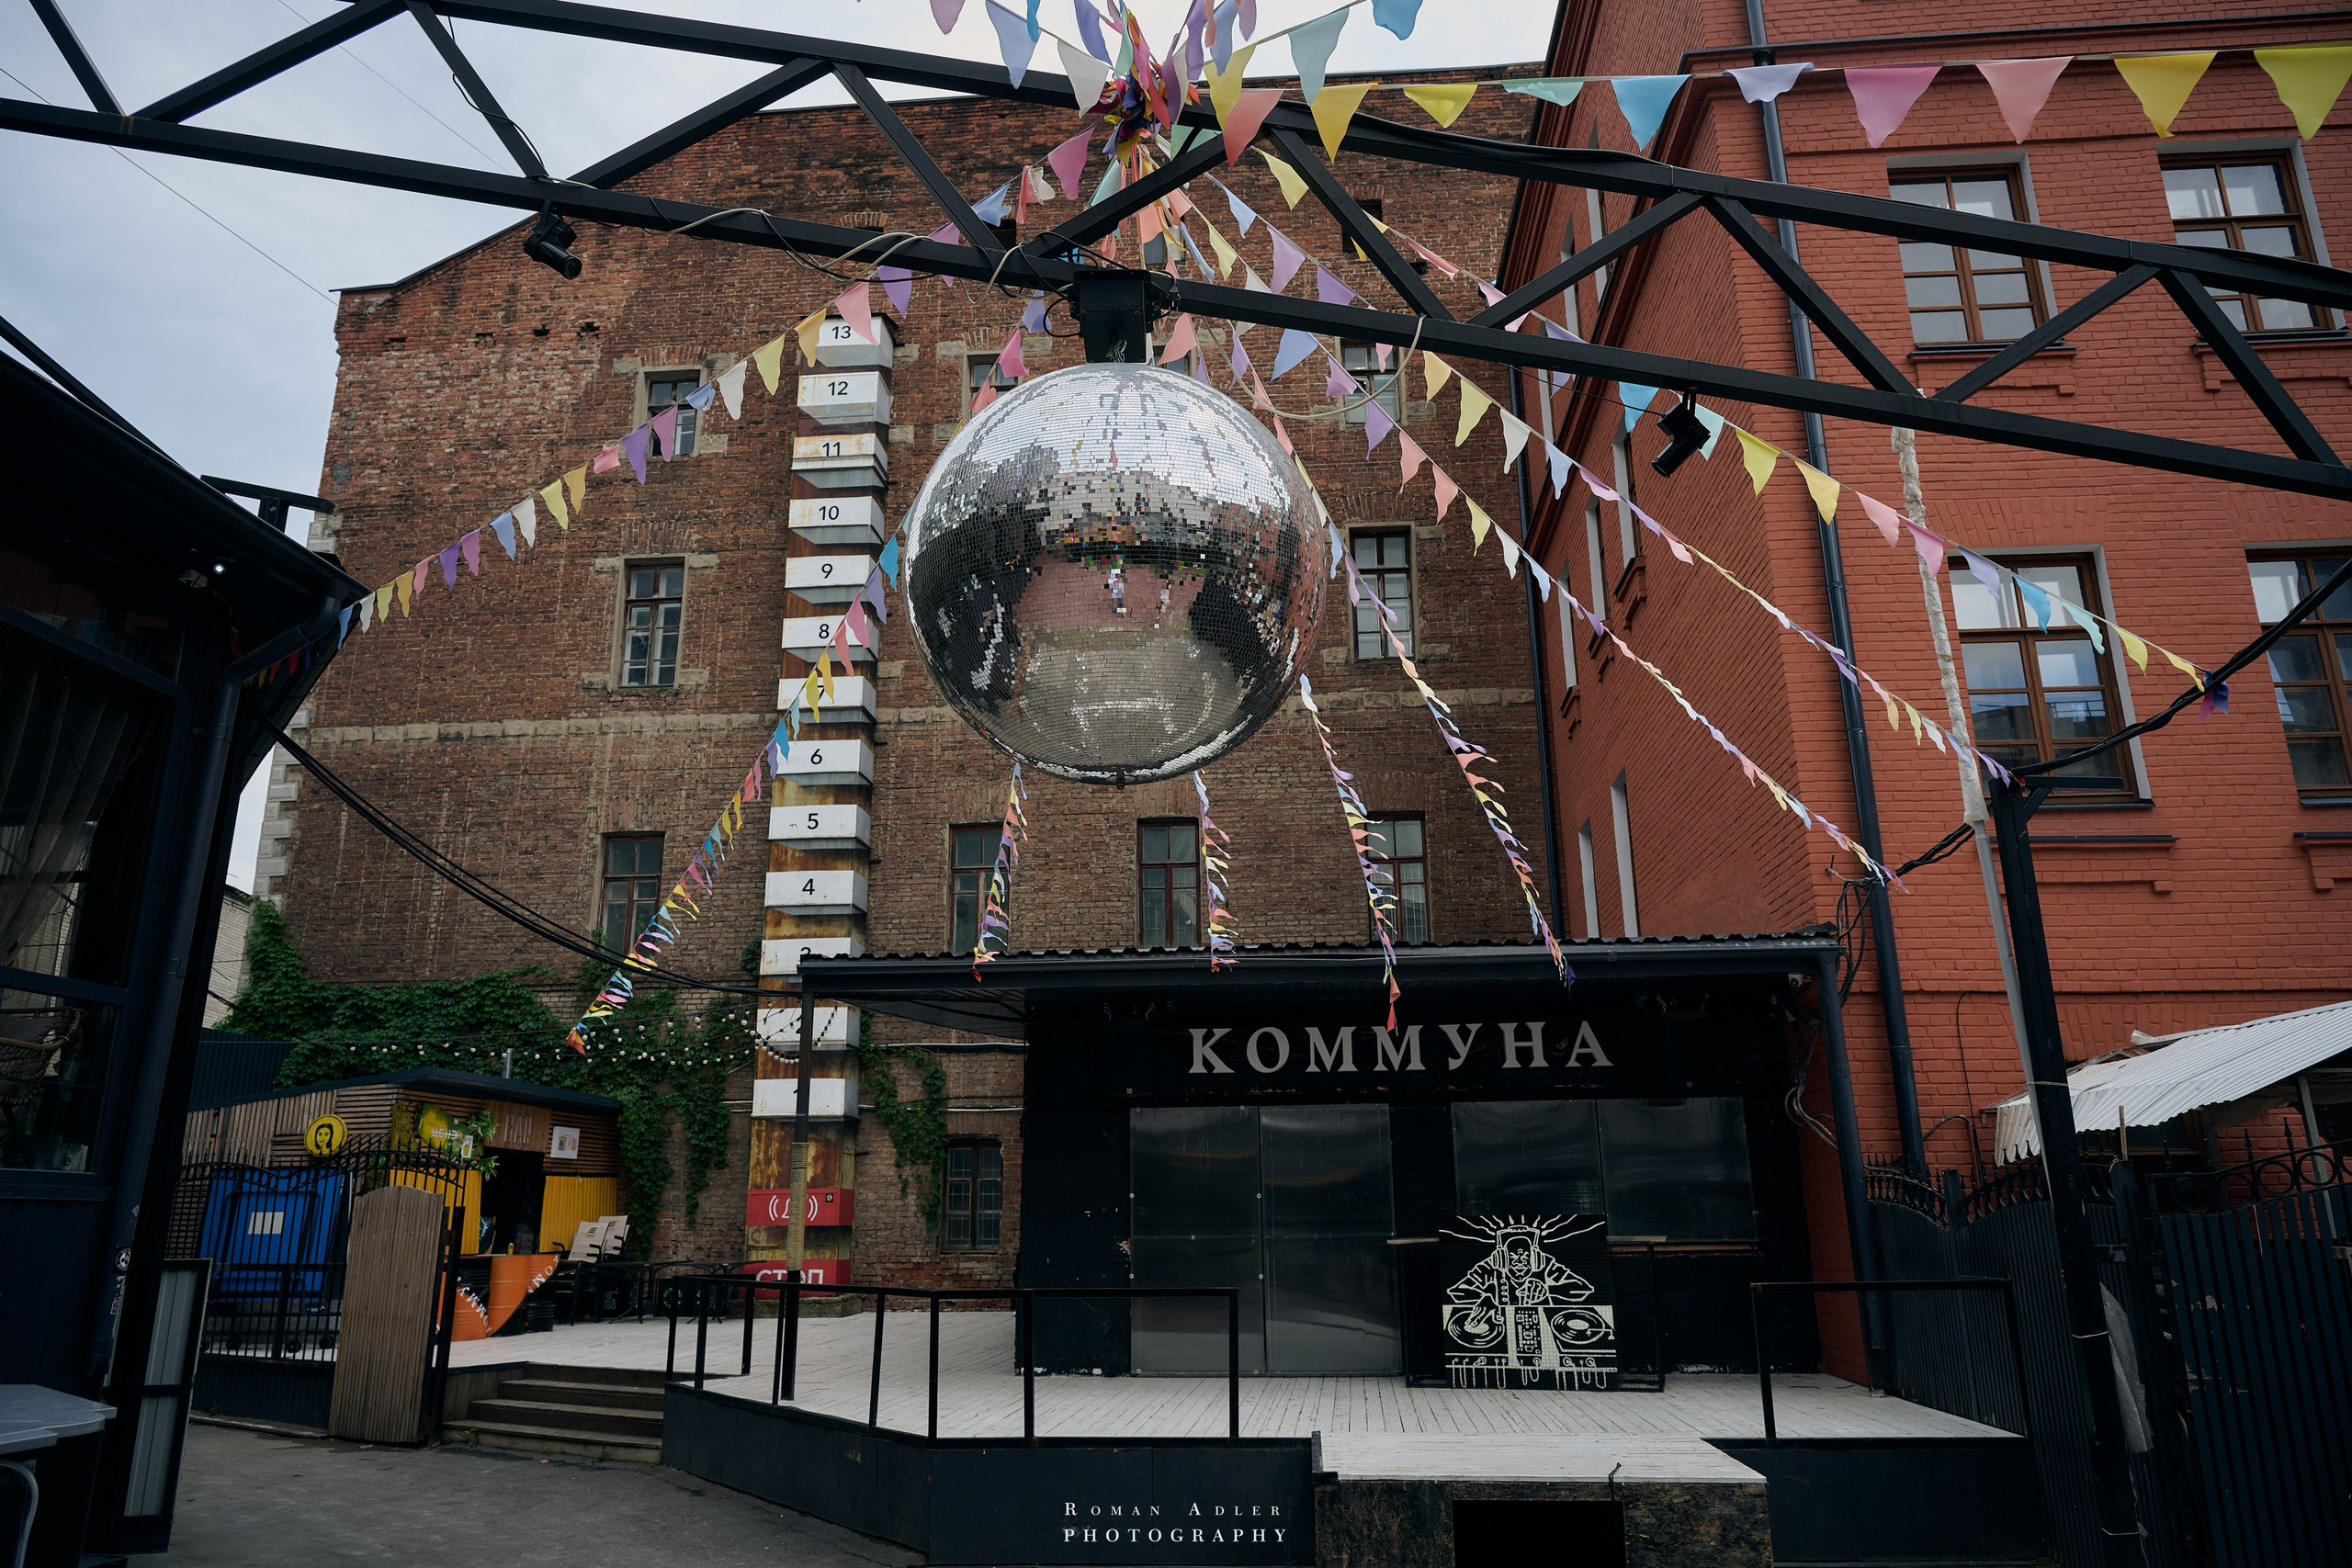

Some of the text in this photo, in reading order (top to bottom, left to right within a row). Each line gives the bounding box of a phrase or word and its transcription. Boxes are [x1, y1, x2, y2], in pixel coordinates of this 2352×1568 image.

[831, 325, 852, 340] 13
[828, 380, 849, 396] 12
[822, 441, 842, 457] 11
[819, 505, 840, 521] 10
[820, 563, 833, 579] 9
[818, 623, 831, 639] 8
[810, 748, 823, 765] 6
[807, 812, 820, 830] 5
[801, 878, 816, 896] 4
[1188, 1021, 1614, 1074] КОММУНА
[503, 1112, 533, 1145] BAR
